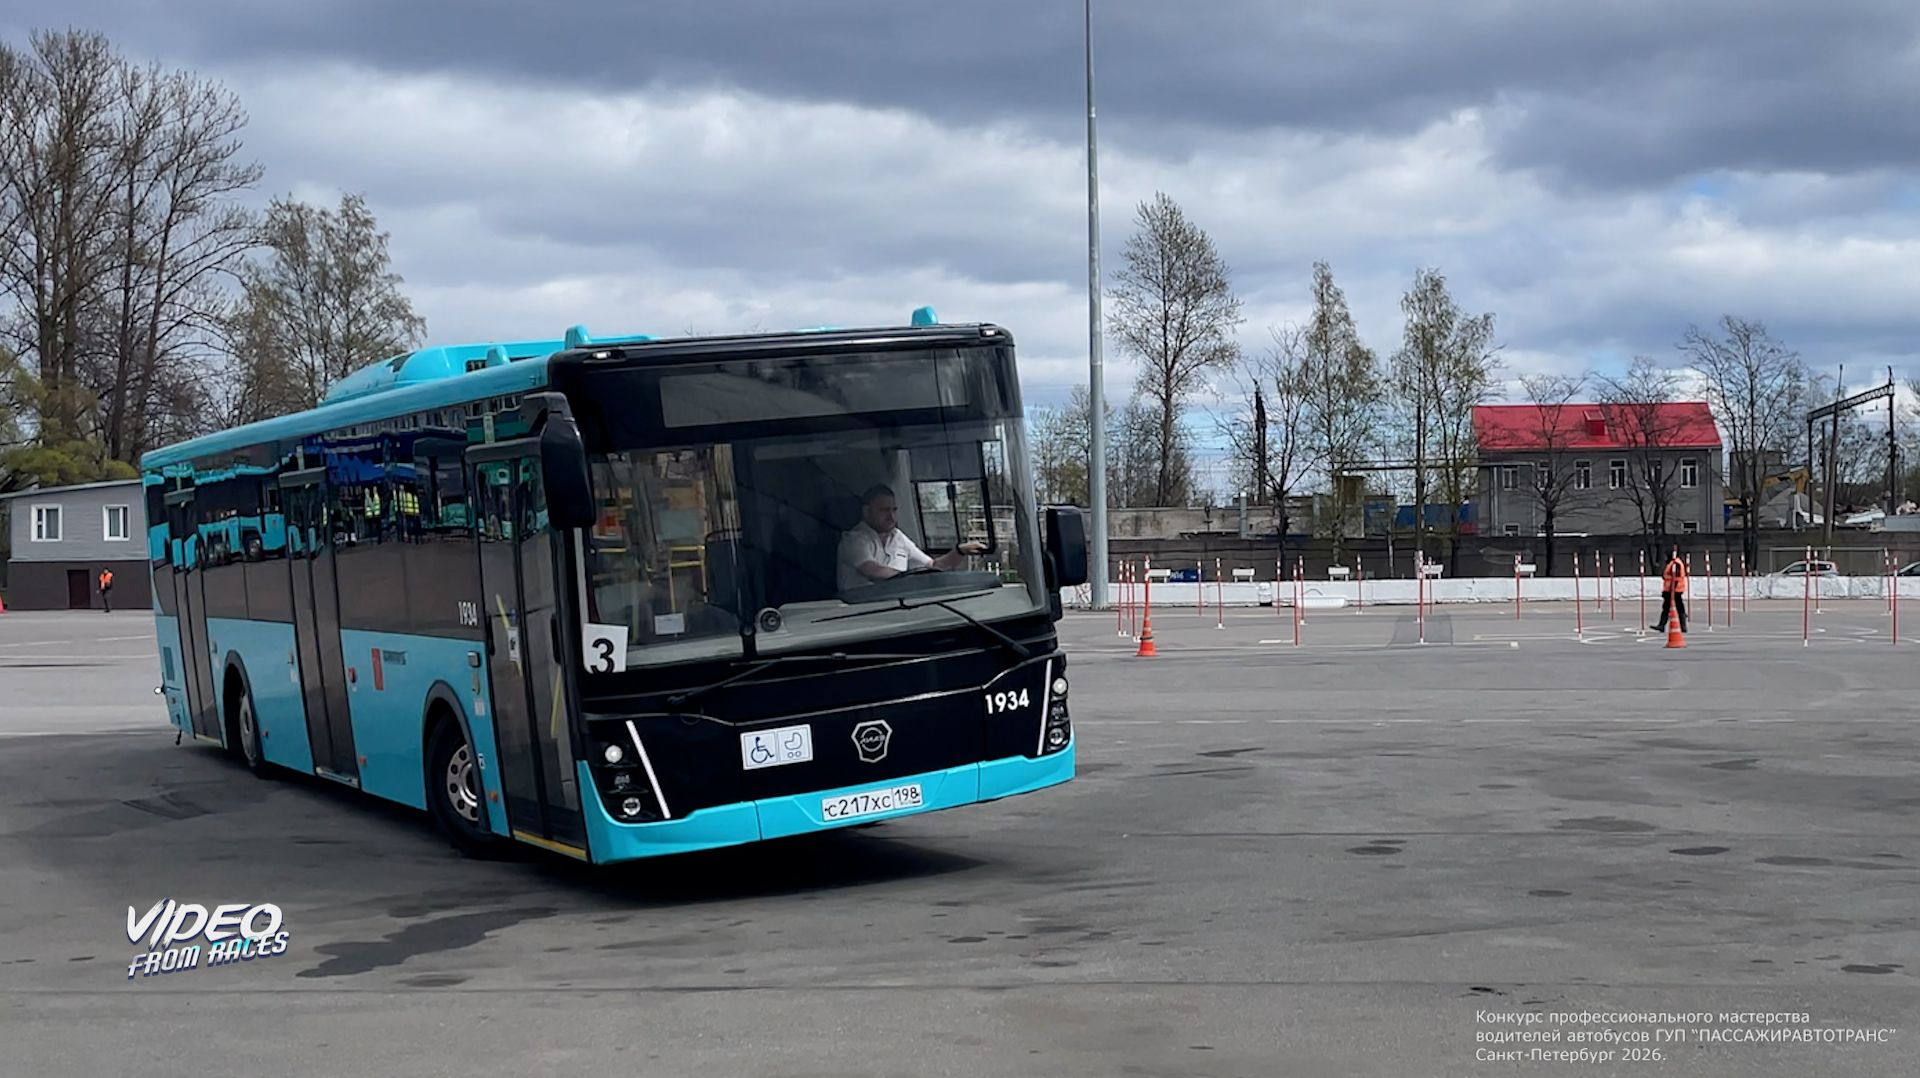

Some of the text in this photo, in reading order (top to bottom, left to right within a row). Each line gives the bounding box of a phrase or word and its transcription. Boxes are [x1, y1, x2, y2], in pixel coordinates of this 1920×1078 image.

[458, 601, 478, 626] 1934
[590, 637, 615, 674] 3
[985, 688, 1030, 714] 1934
[895, 787, 917, 801] 198
